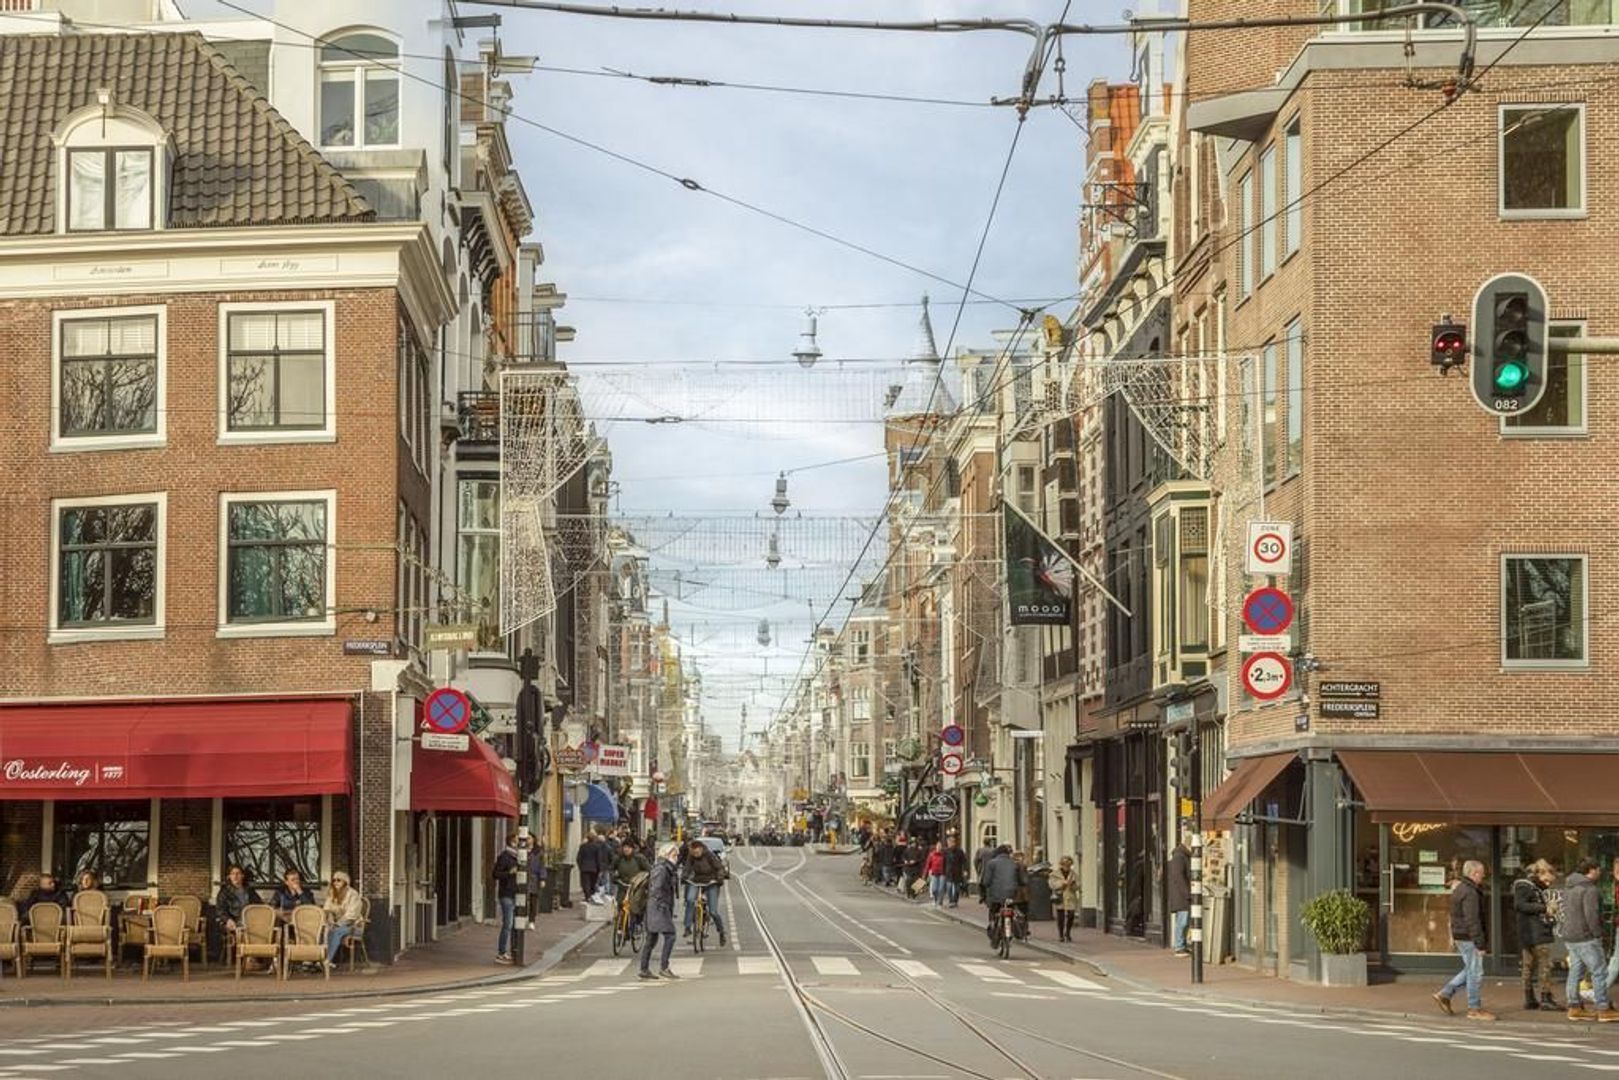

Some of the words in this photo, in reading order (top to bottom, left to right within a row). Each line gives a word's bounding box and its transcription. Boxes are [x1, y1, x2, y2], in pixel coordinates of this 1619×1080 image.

[1495, 399, 1518, 410] 082
[1260, 542, 1279, 553] 30
[1018, 603, 1066, 613] moooi
[345, 641, 388, 649] FREDERIKSPLEIN
[1321, 684, 1378, 692] ACHTERGRACHT
[1322, 703, 1377, 711] FREDERIKSPLEIN
[604, 749, 625, 758] SUPER
[599, 759, 626, 767] MARKET
[3, 759, 90, 786] Oosterling
